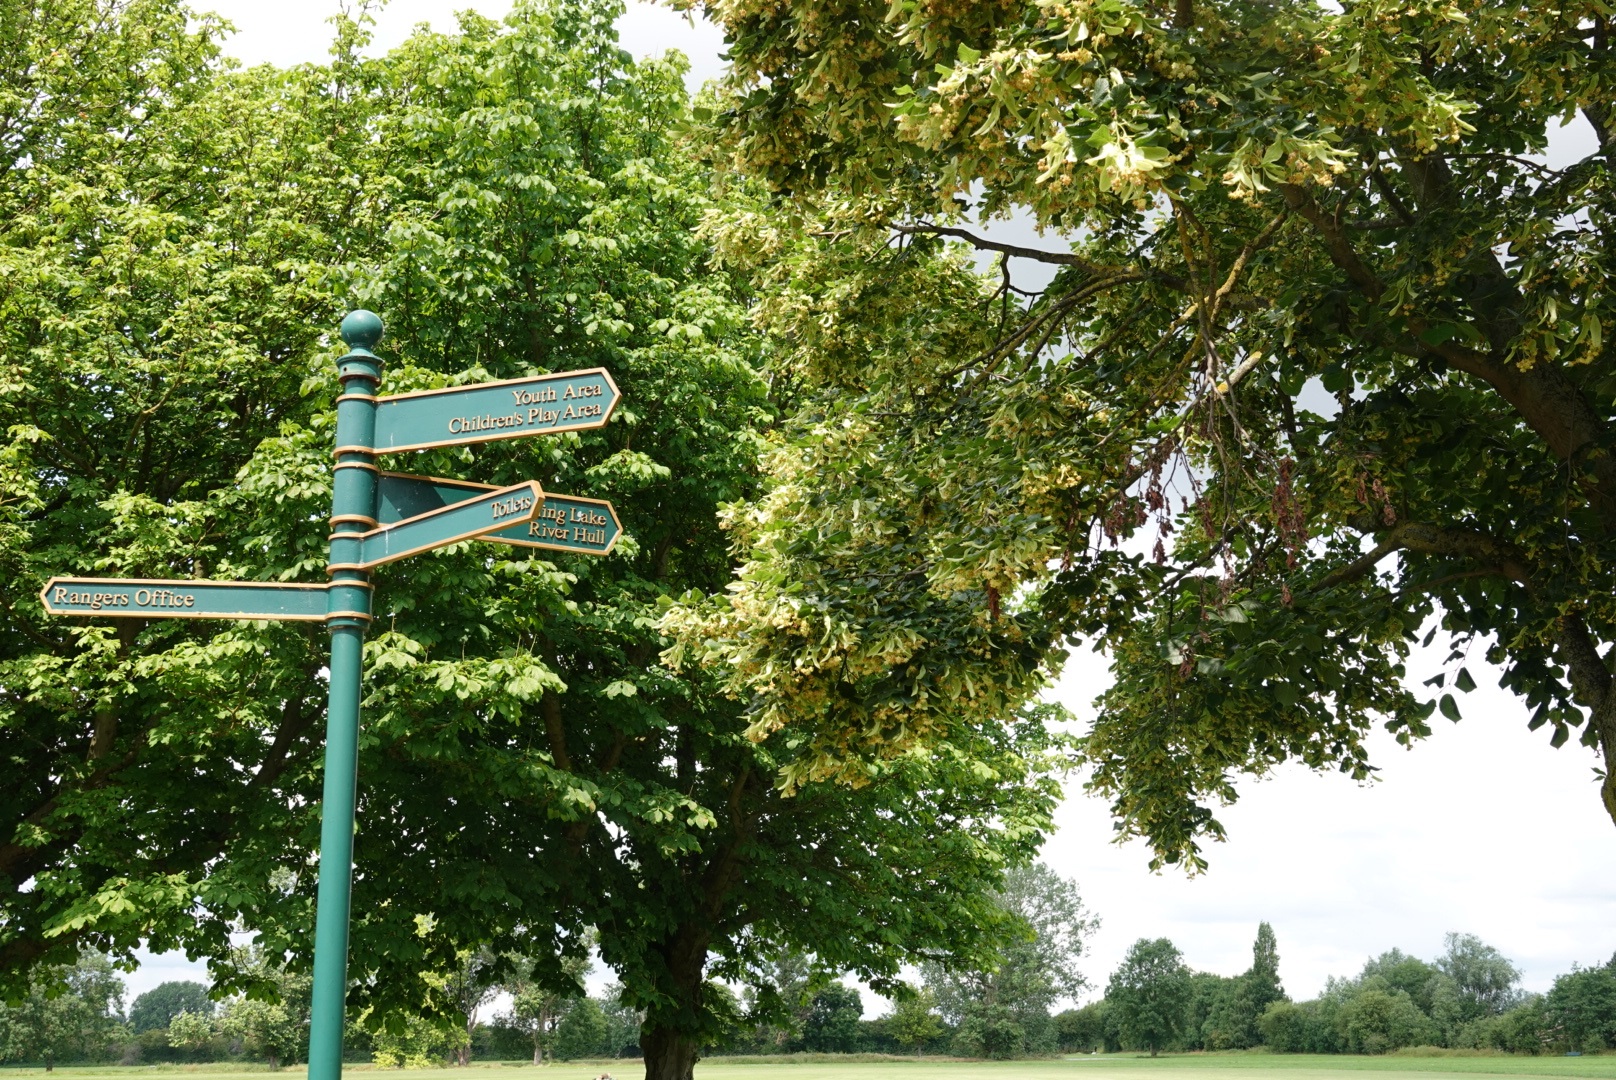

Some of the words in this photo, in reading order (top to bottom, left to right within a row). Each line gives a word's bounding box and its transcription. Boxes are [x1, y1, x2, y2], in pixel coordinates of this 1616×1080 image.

[512, 386, 557, 405] Youth
[563, 383, 602, 400] Area
[448, 412, 523, 433] Children's
[528, 408, 561, 427] Play
[563, 403, 602, 419] Area
[491, 496, 532, 518] Toilets
[538, 504, 566, 525] ing
[570, 507, 607, 526] Lake
[528, 521, 569, 540] River
[574, 527, 605, 544] Hull
[53, 587, 129, 608] Rangers
[134, 589, 194, 607] Office
